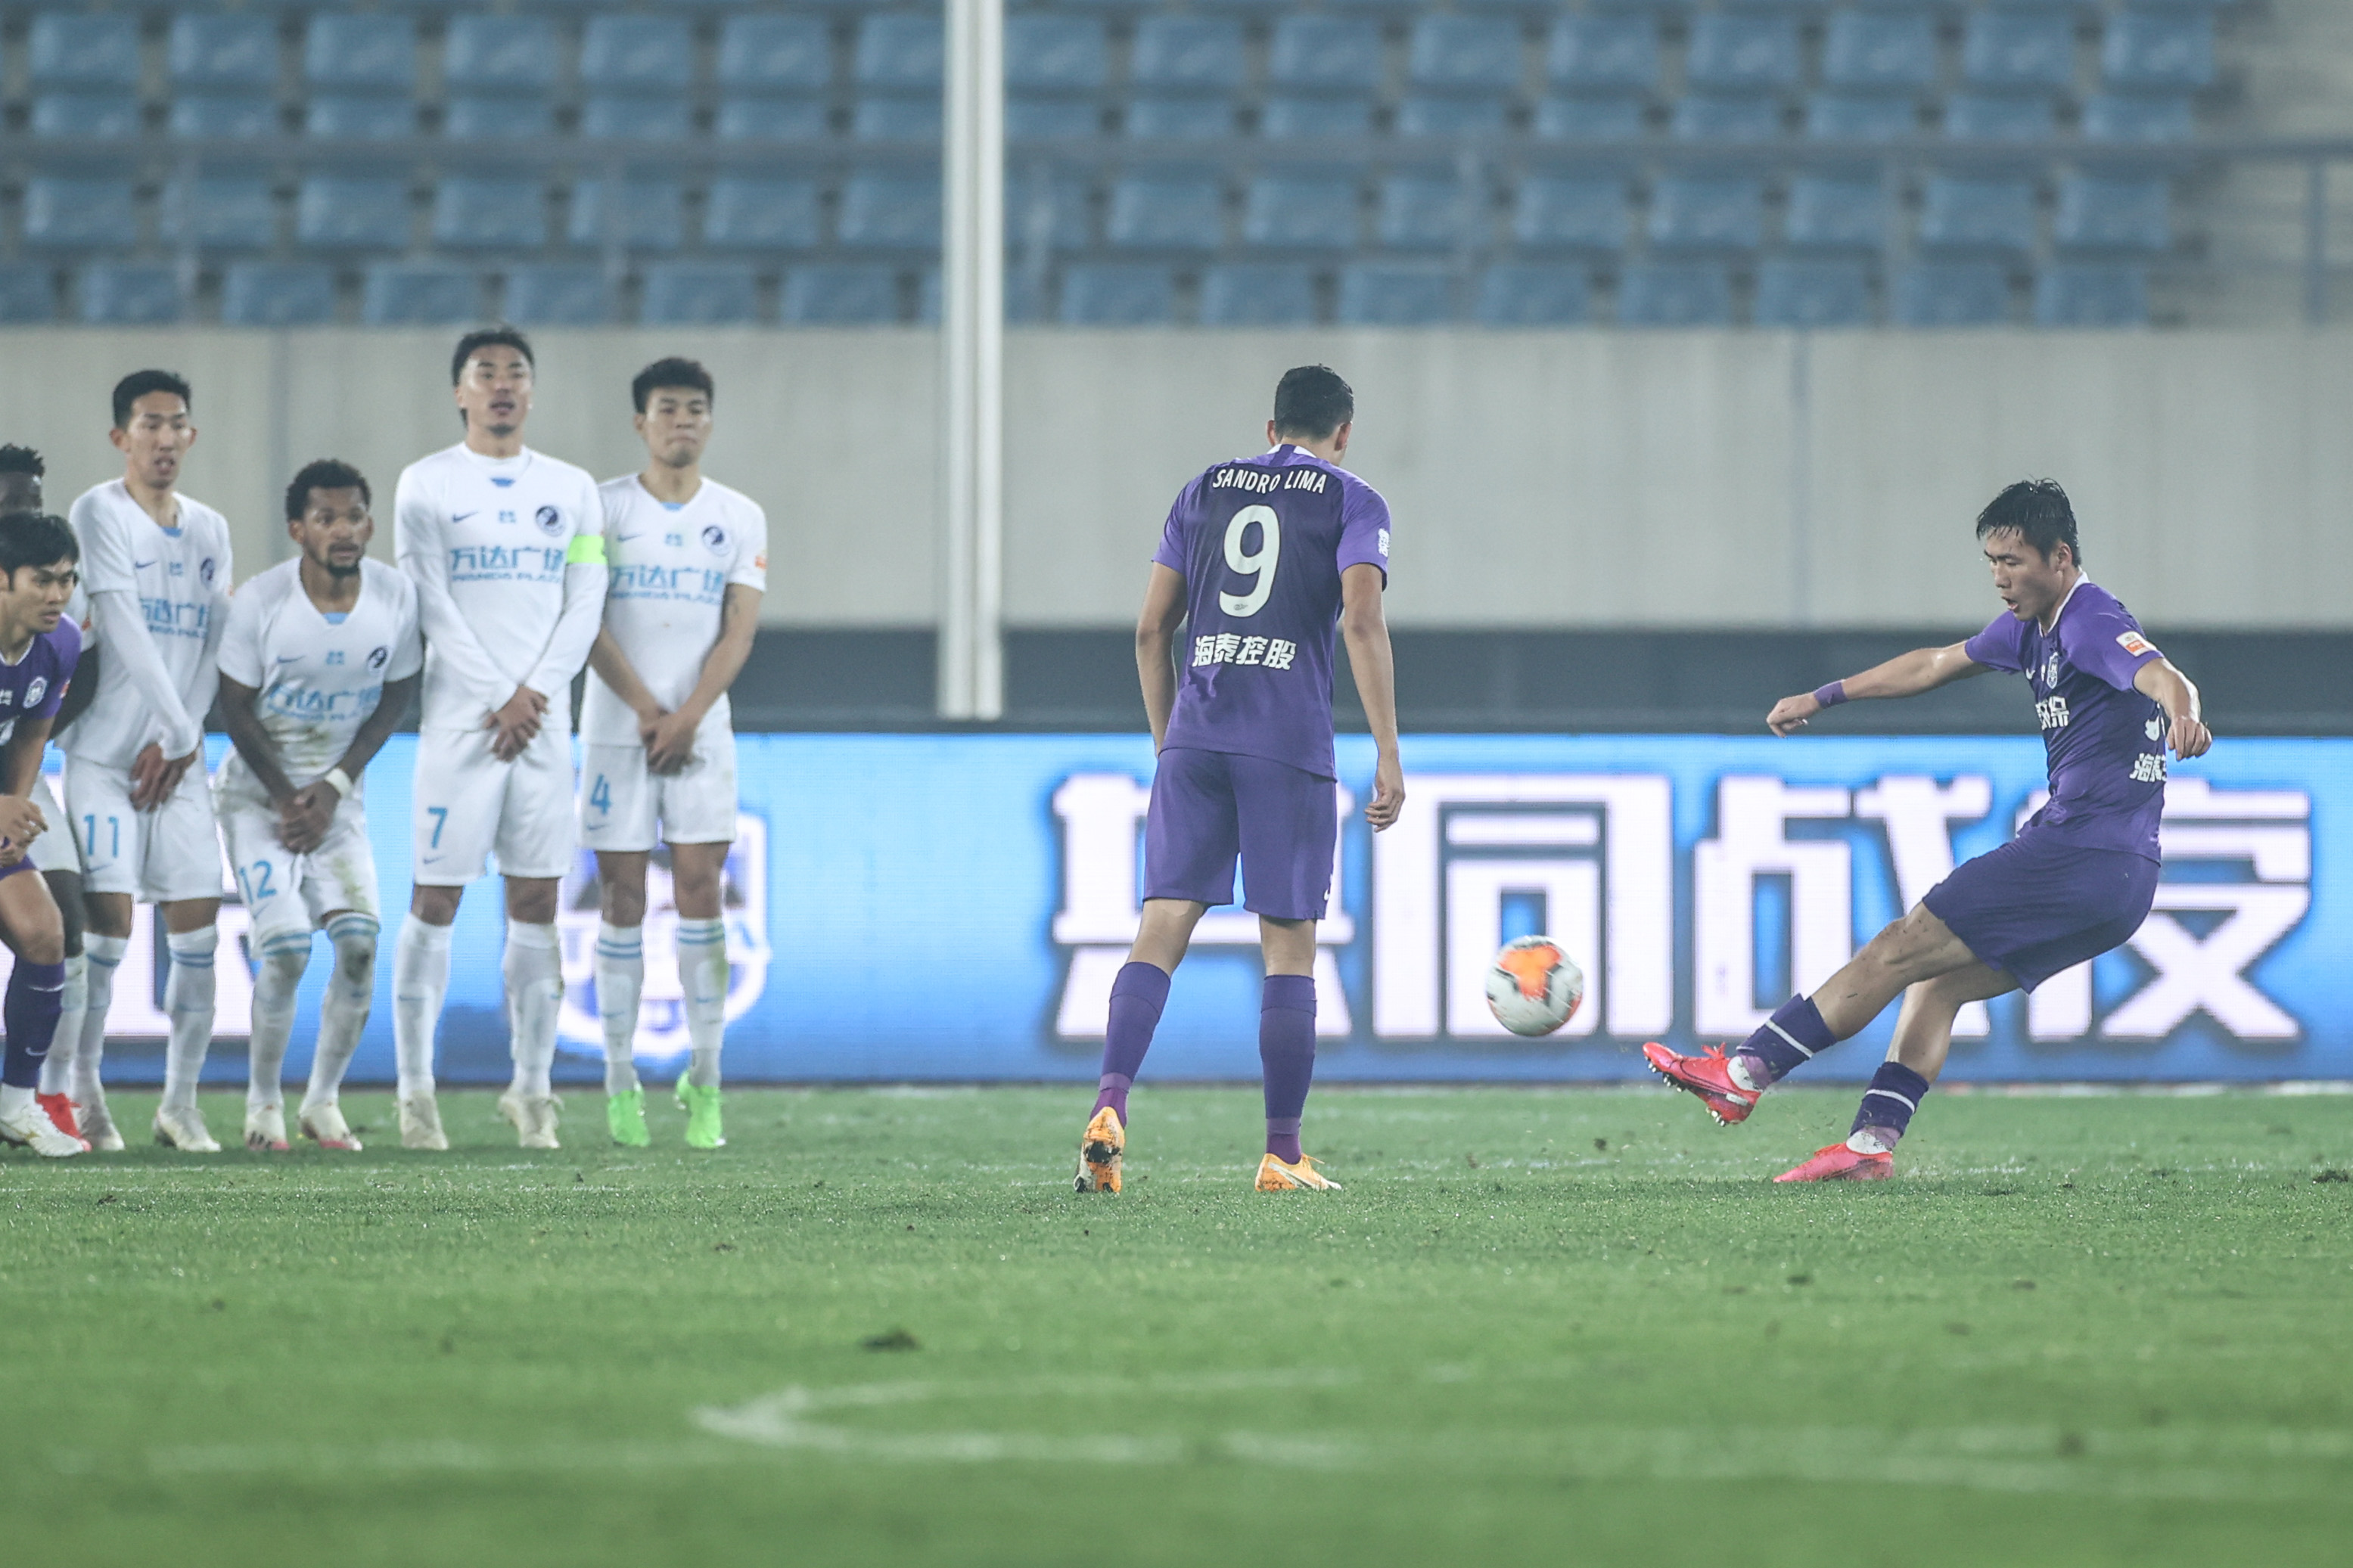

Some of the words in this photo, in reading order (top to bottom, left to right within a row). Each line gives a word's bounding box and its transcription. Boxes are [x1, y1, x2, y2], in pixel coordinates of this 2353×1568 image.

[1212, 468, 1281, 494] SANDRO
[1284, 470, 1327, 494] LIMA
[1219, 505, 1280, 617] 9
[1192, 632, 1296, 670] 海泰控股
[590, 773, 613, 815] 4
[83, 814, 118, 858] 11
[426, 806, 448, 849] 7
[238, 859, 277, 905] 12
